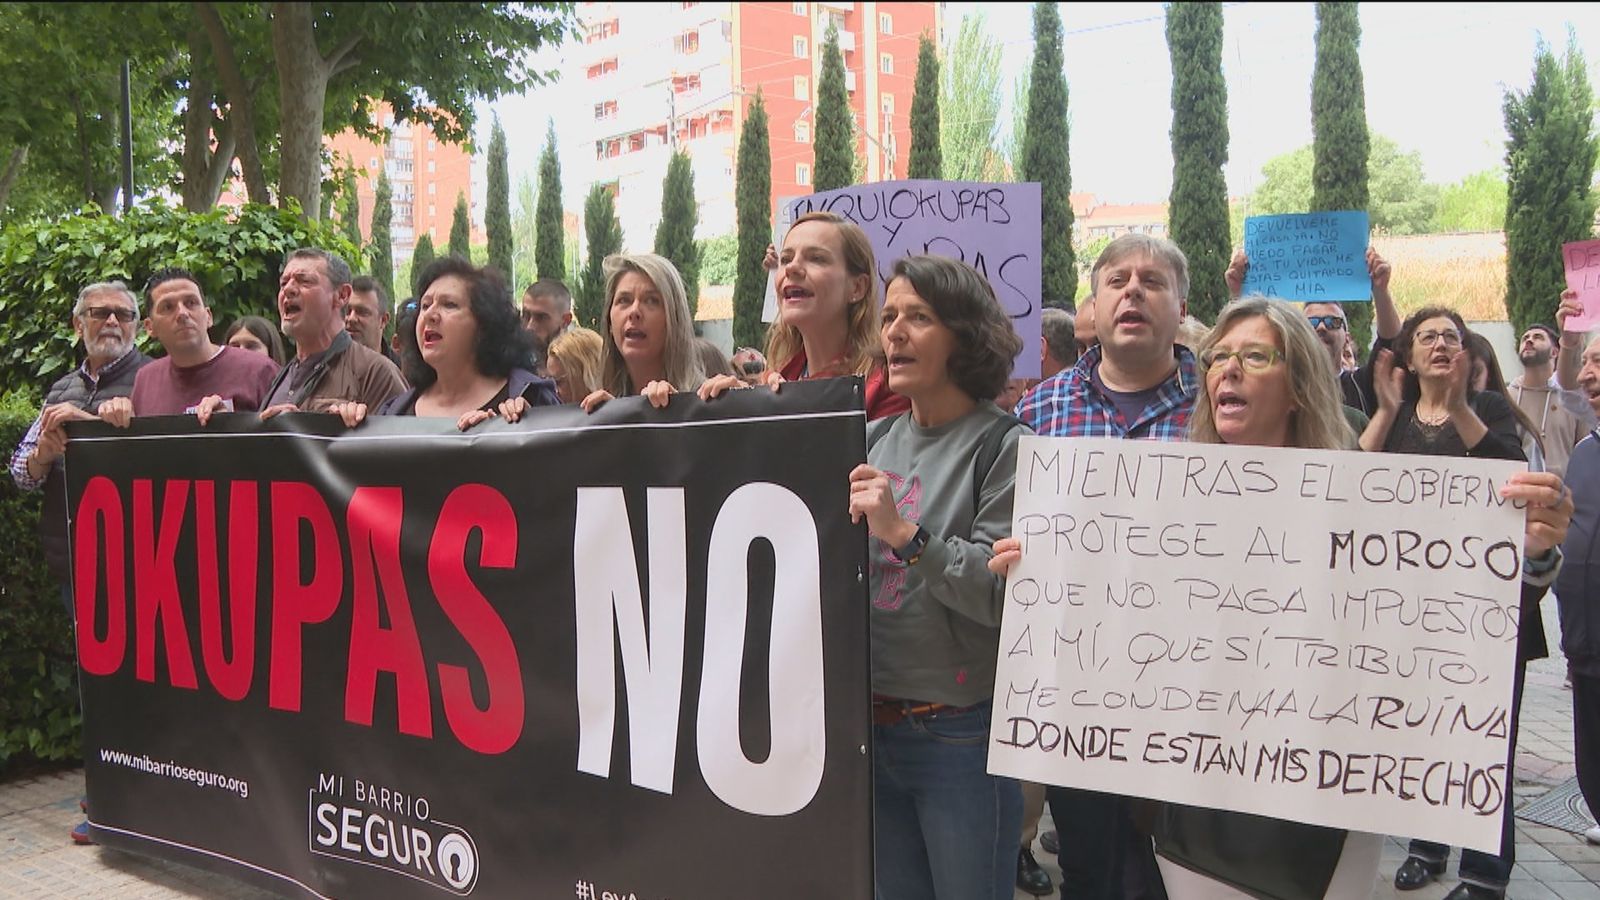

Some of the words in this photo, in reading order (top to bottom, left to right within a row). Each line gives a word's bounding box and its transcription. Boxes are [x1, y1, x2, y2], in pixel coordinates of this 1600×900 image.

[882, 221, 903, 248] Y
[1247, 217, 1339, 236] DEVUELVEME
[1292, 243, 1337, 256] PAGAR
[1318, 229, 1339, 241] NO
[1273, 259, 1290, 270] TU
[1289, 268, 1354, 280] QUITANDO
[1029, 448, 1279, 501] MIENTRAS
[1300, 463, 1348, 502] EL
[1018, 511, 1225, 557] PROTEGE
[1244, 525, 1301, 564] AL
[1329, 529, 1521, 581] MOROSO
[1011, 577, 1087, 613] QUE
[1174, 578, 1308, 615] PAGA
[1331, 587, 1520, 643] IMPUESTOS
[75, 475, 526, 755] OKUPAS
[573, 481, 827, 817] NO
[1007, 623, 1034, 659] A
[1053, 621, 1110, 672] MÍ,
[1127, 632, 1213, 682] QUE
[1224, 626, 1271, 670] SÍ,
[1004, 677, 1061, 716] ME
[1273, 688, 1298, 718] A
[1308, 693, 1359, 725] LA
[100, 748, 249, 798] www.mibarrioseguro.org
[995, 716, 1132, 762] DONDE
[1142, 731, 1248, 777] ESTAN
[1316, 749, 1506, 816] DERECHOS
[318, 773, 344, 797] MI
[355, 779, 431, 822] BARRIO
